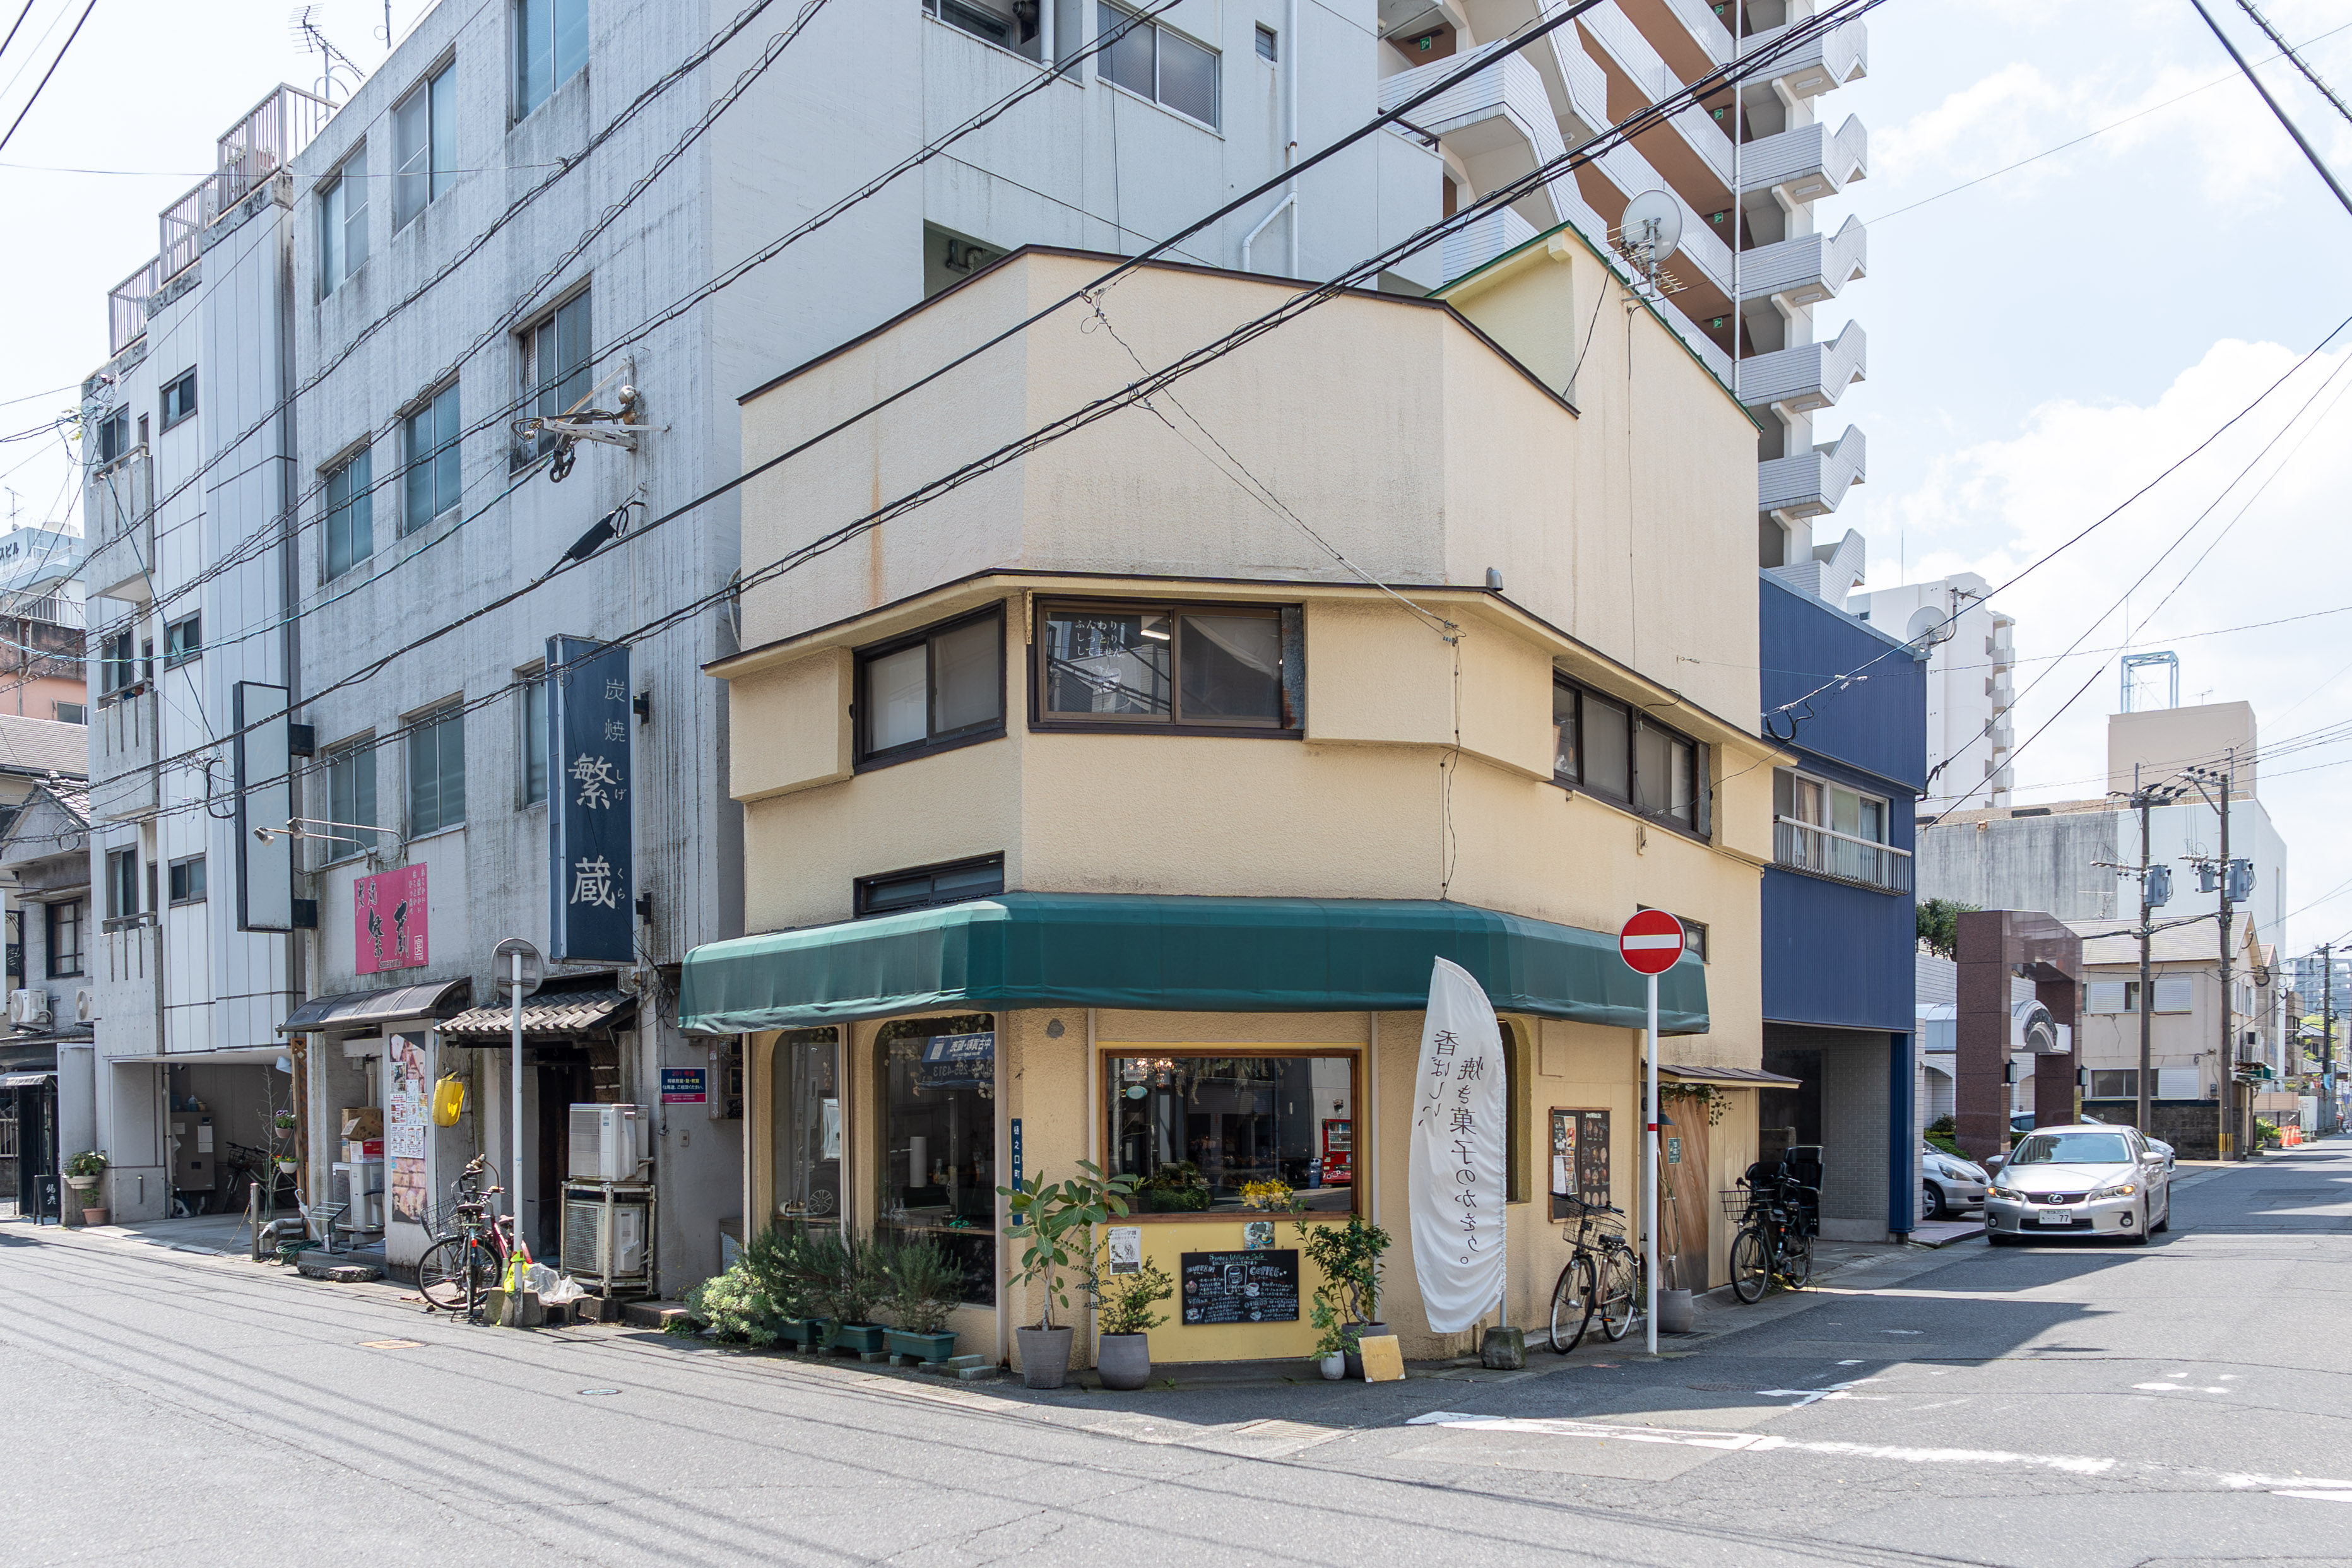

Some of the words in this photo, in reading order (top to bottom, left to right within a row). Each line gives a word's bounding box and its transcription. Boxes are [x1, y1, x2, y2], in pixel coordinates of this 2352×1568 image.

[1075, 620, 1117, 630] ふんわり
[1077, 633, 1118, 644] しっとり
[1077, 646, 1125, 658] してません。
[605, 678, 626, 743] 炭焼
[615, 769, 627, 801] しげ
[567, 752, 616, 909] 繁蔵
[617, 867, 625, 900] くら
